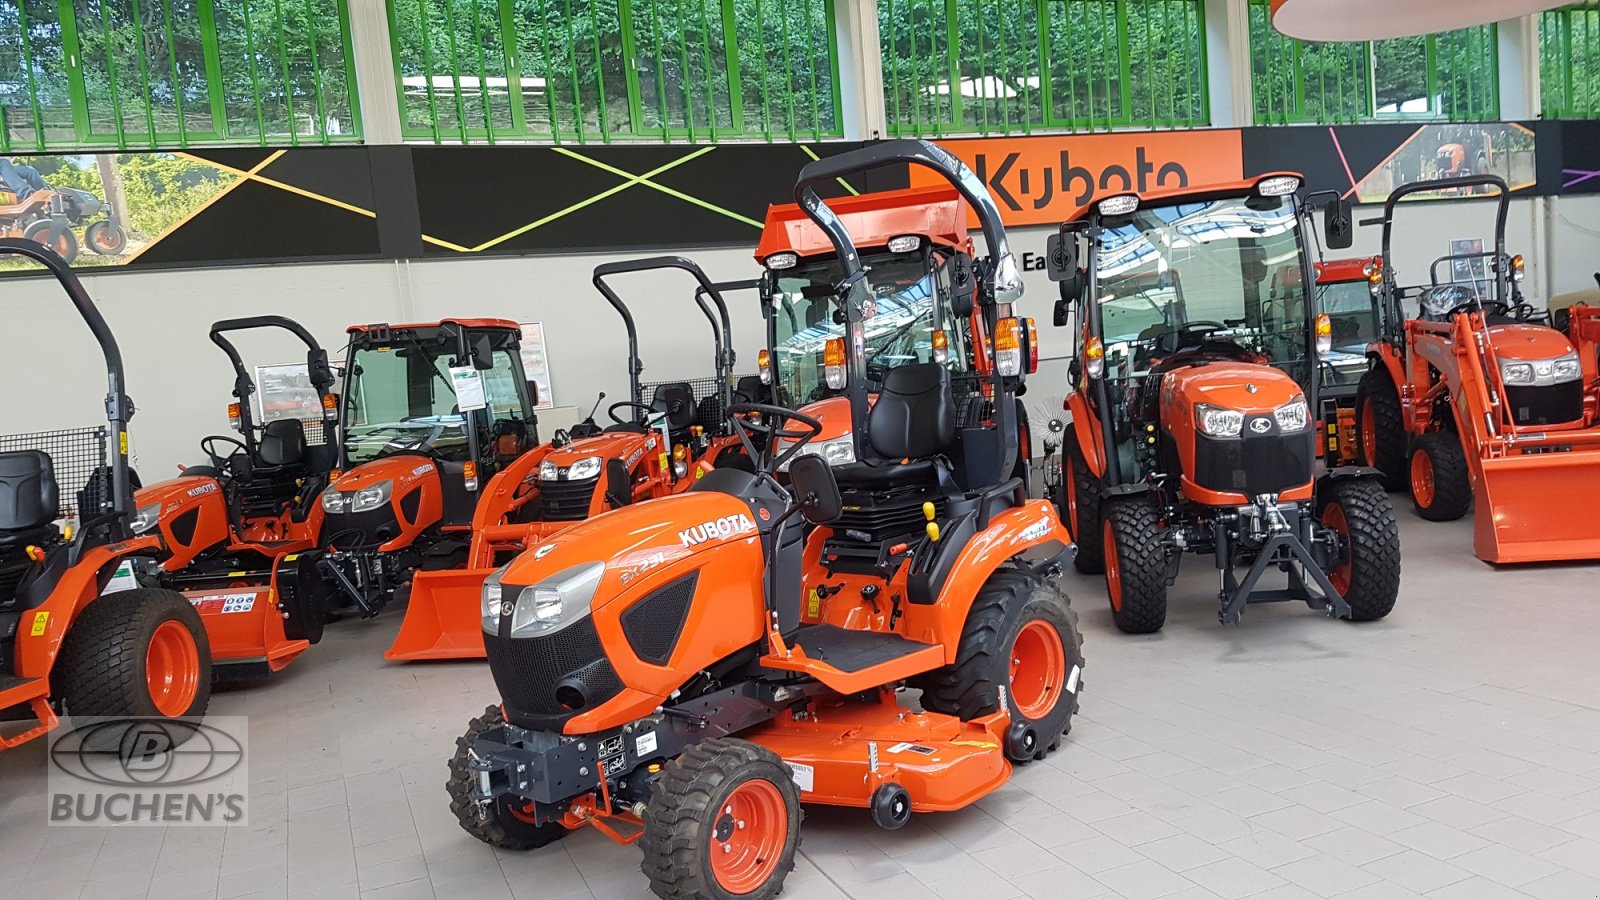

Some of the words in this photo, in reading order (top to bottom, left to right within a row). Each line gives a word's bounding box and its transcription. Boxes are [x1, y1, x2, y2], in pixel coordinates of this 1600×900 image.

[976, 147, 1188, 211] Kubota
[1022, 252, 1048, 272] Ea
[187, 483, 217, 497] KUBOTA
[678, 513, 757, 548] KUBOTA
